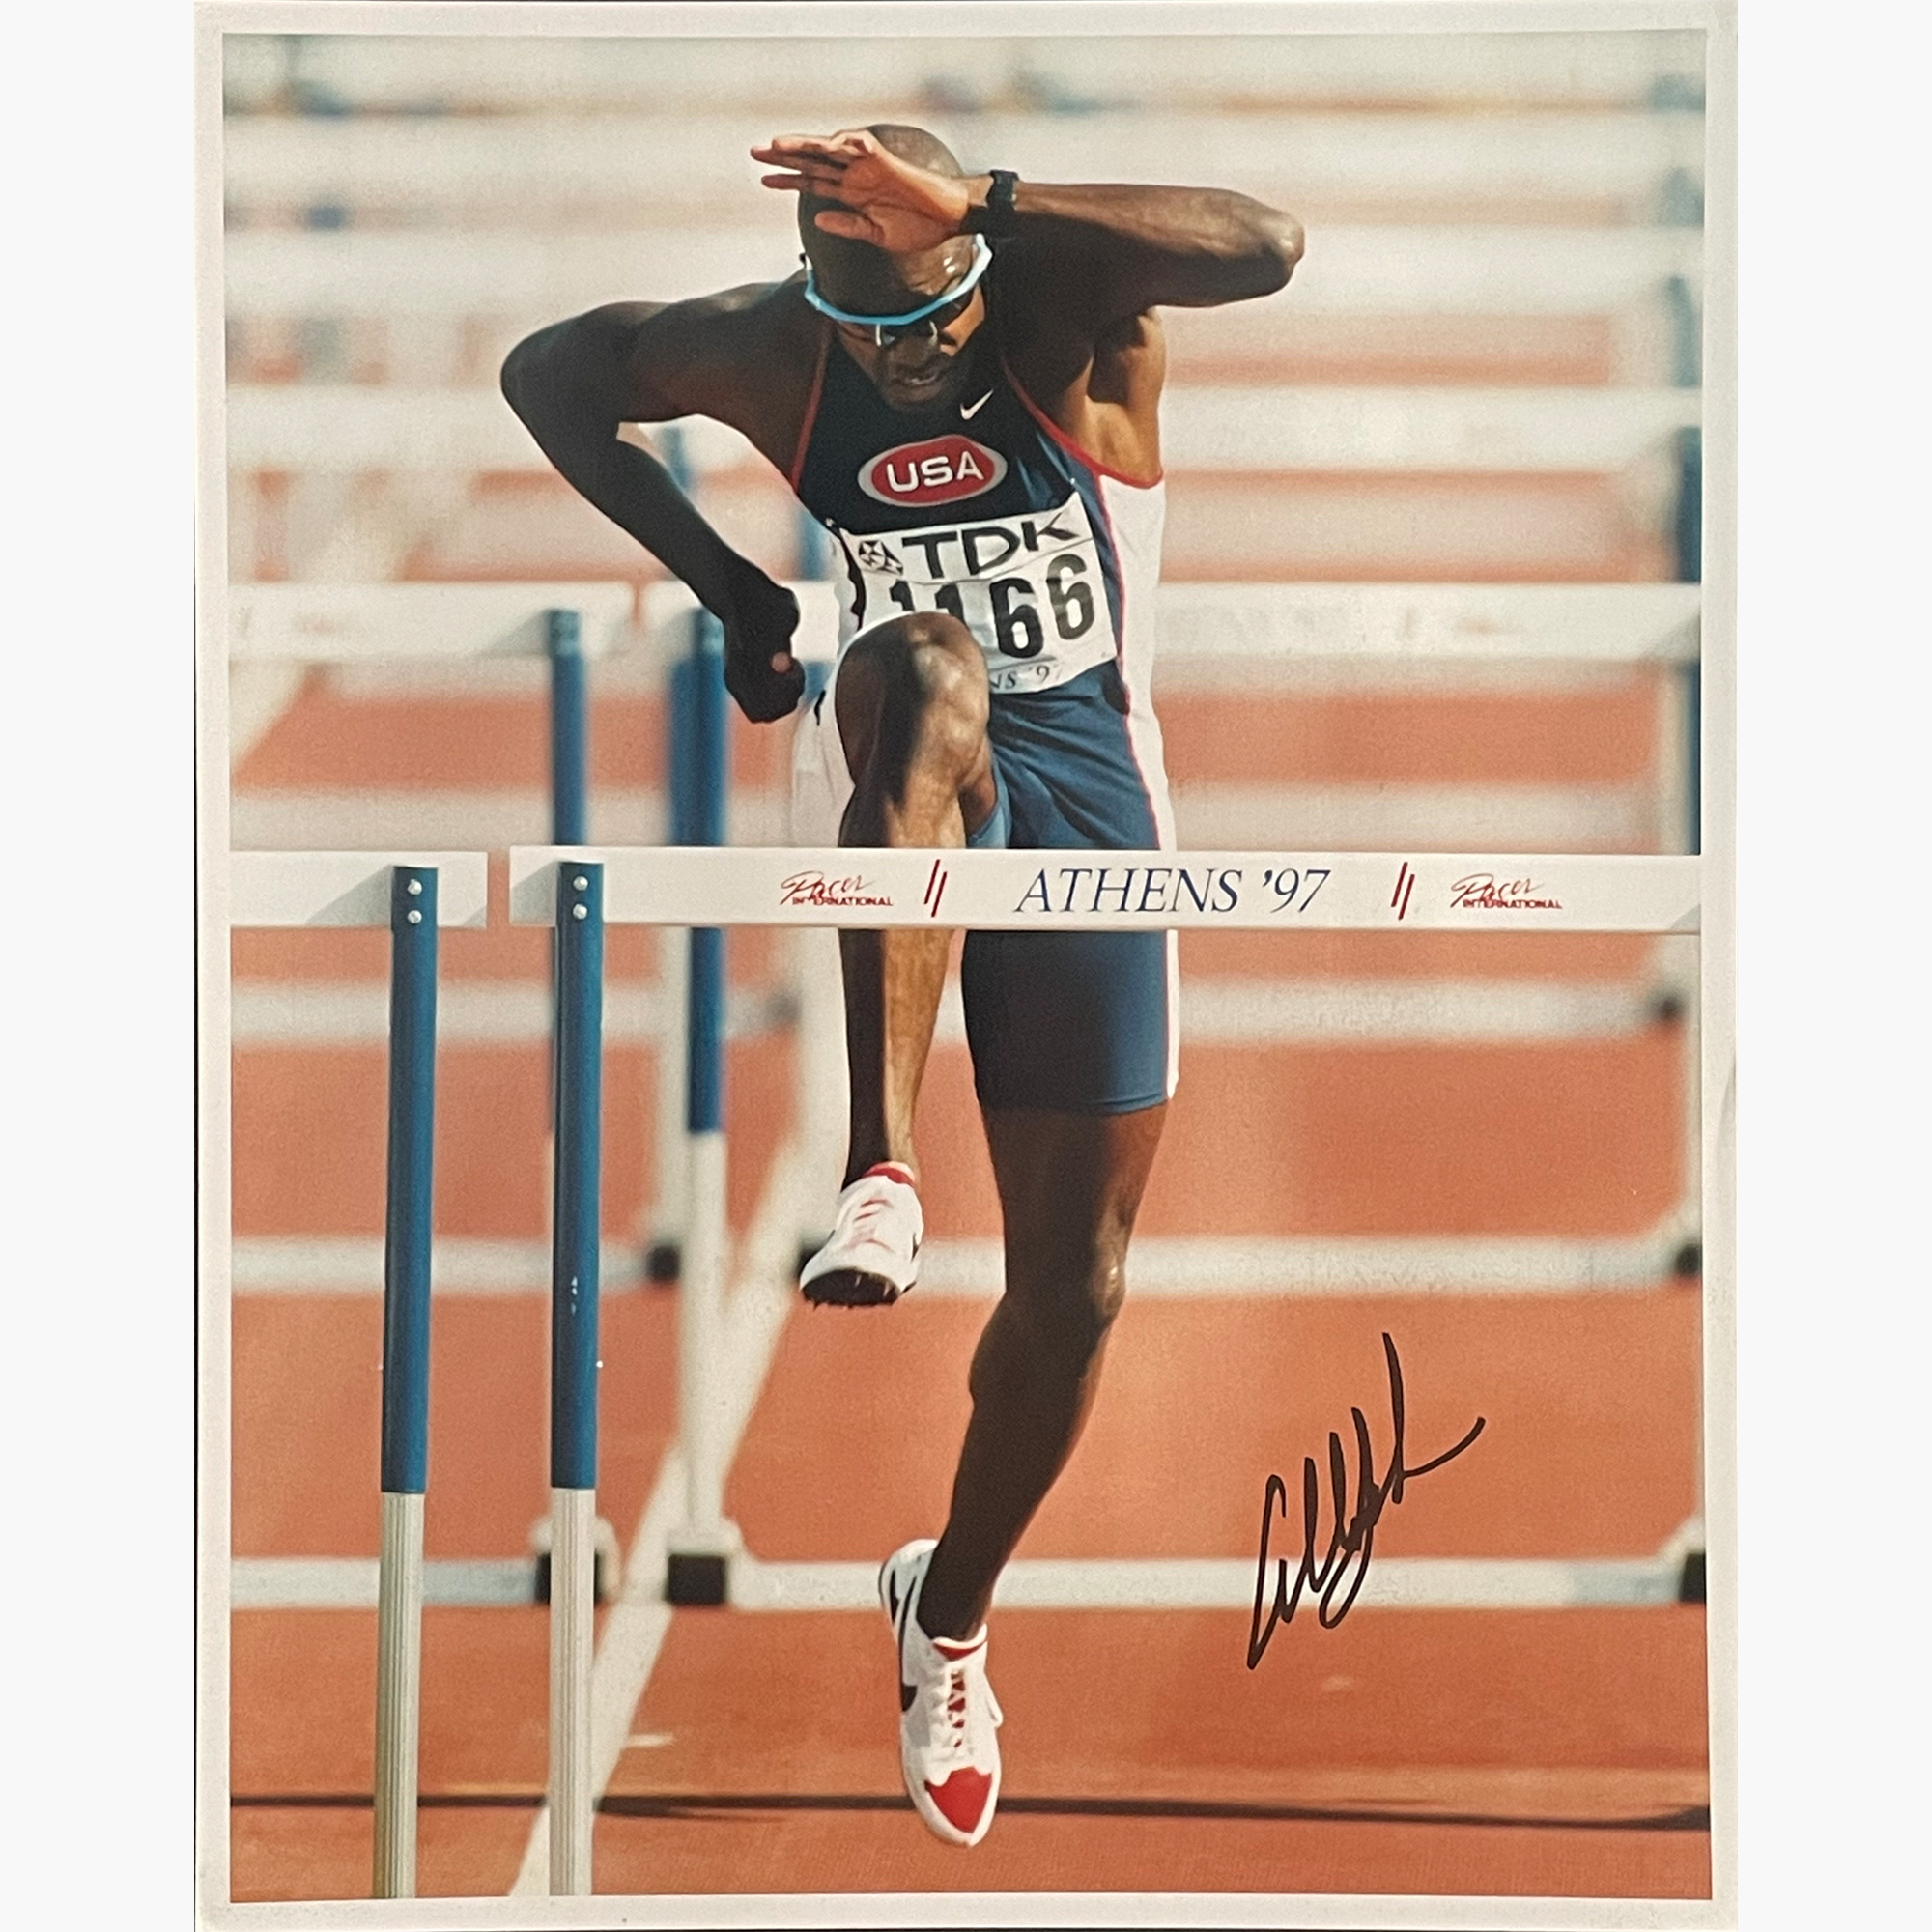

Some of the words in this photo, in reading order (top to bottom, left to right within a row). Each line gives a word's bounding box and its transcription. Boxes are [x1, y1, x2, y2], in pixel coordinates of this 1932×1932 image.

[886, 450, 984, 494] USA
[901, 512, 1080, 580] TDK
[889, 553, 1095, 659] 1166
[1014, 867, 1243, 913] ATHENS
[1262, 867, 1331, 913] '97
